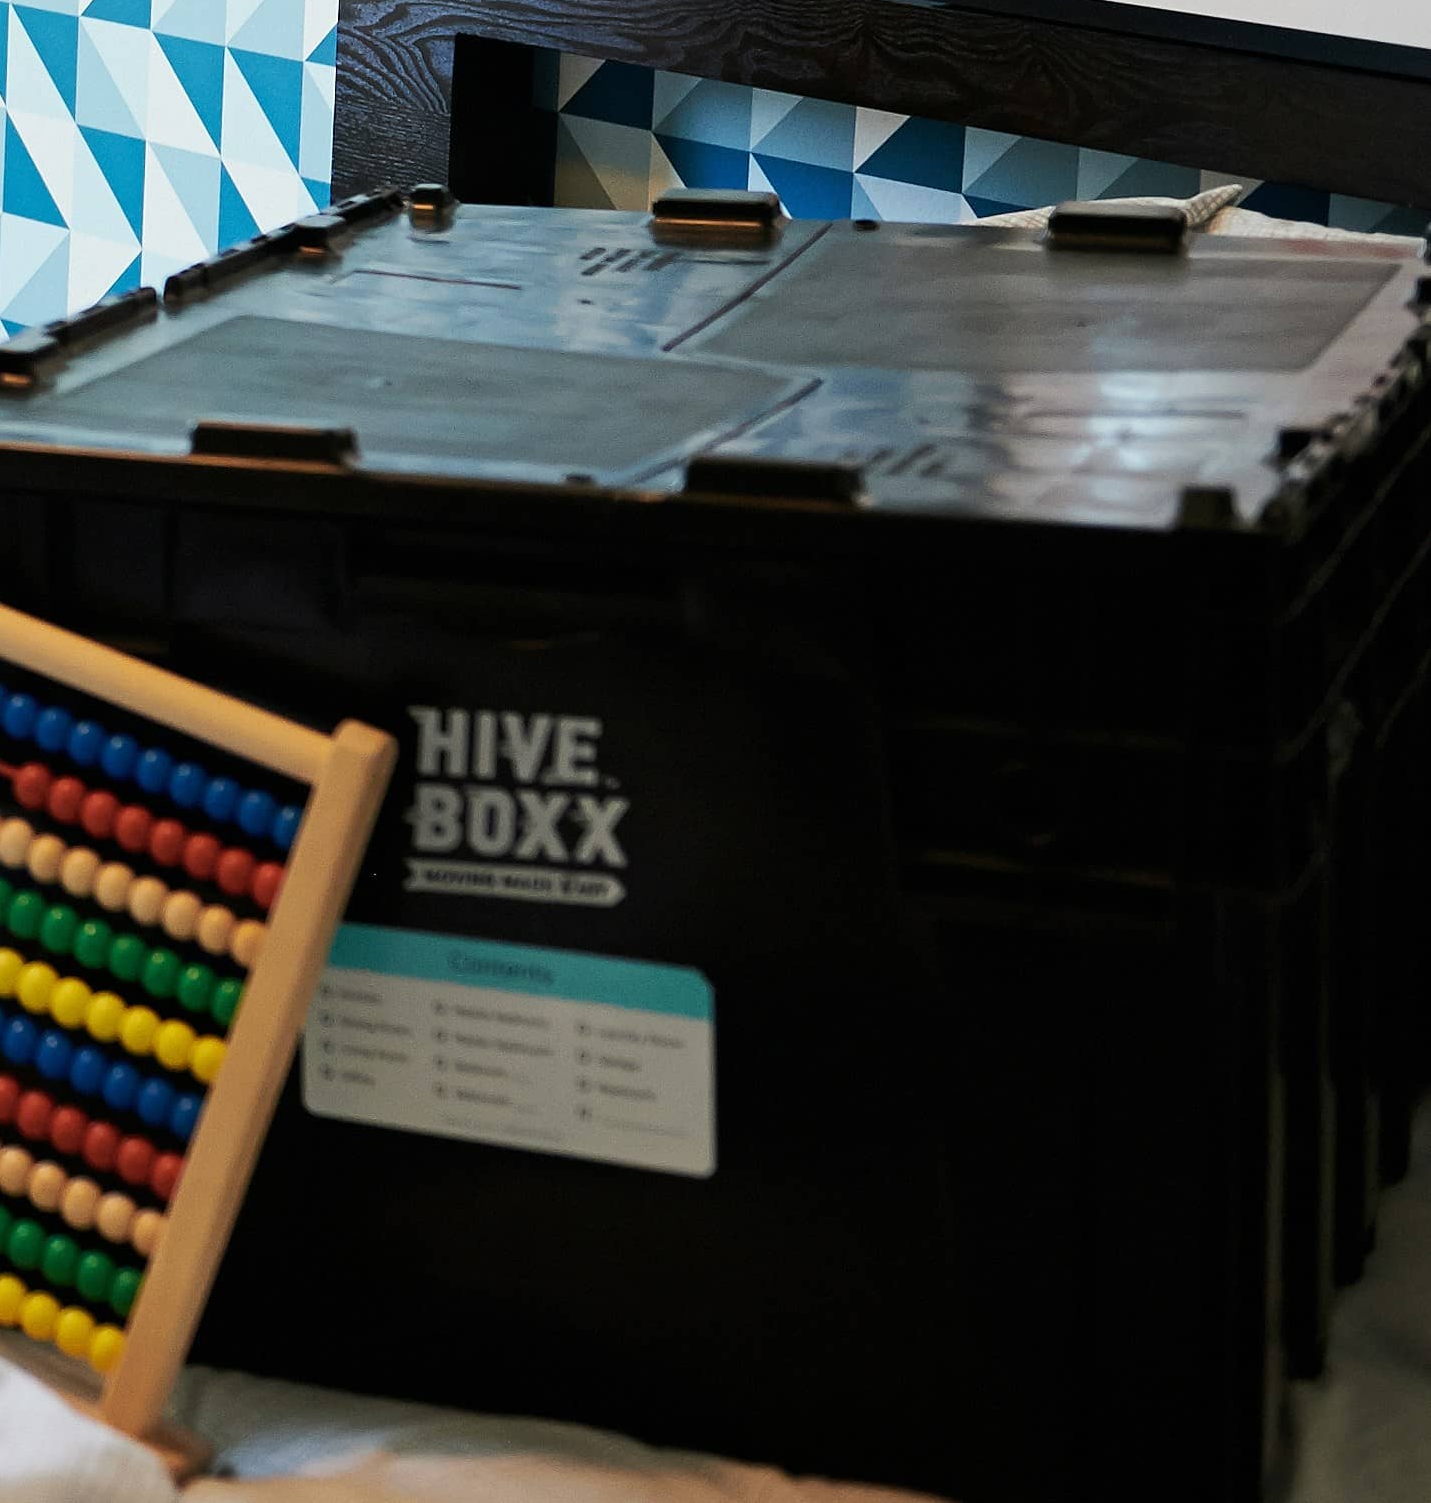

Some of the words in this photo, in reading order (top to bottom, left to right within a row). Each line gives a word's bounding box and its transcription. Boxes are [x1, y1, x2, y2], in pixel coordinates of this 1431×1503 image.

[408, 705, 603, 786] HIVE
[405, 786, 630, 868] BOXX
[448, 950, 556, 986] Contents
